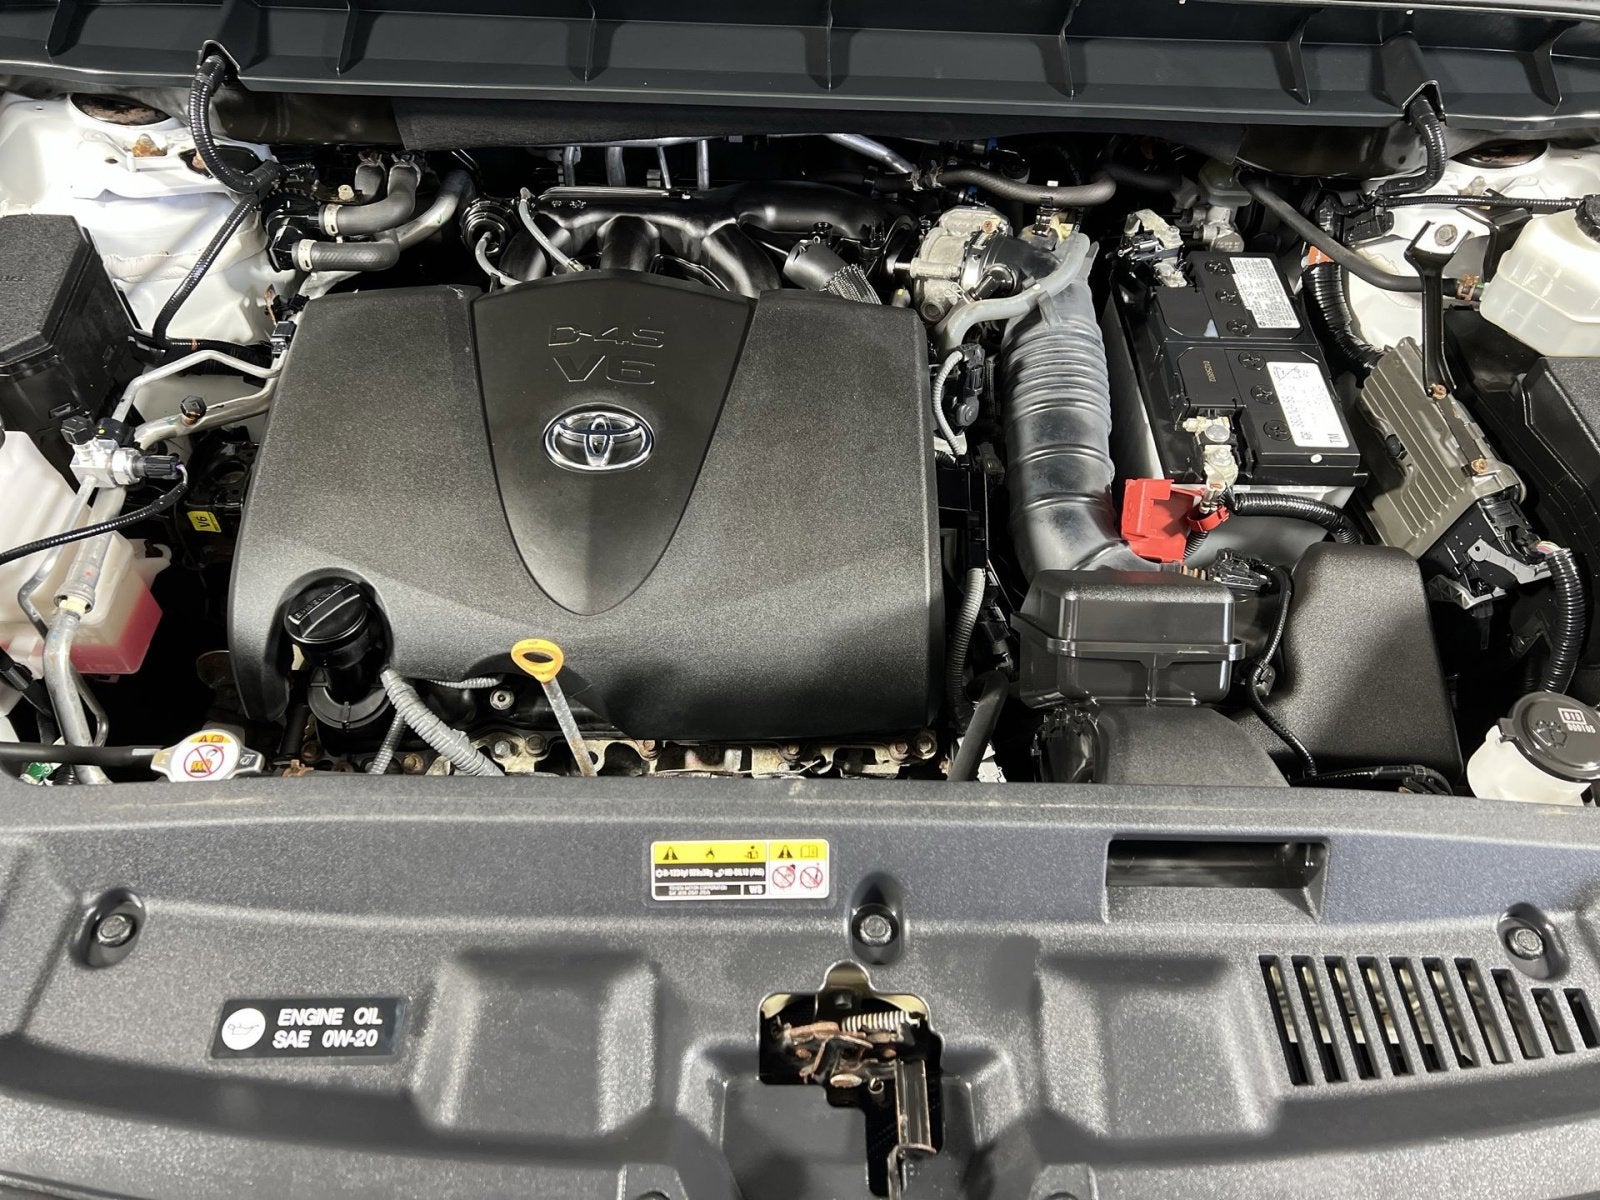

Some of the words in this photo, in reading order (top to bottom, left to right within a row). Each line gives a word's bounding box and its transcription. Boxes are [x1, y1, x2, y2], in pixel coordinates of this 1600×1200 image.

[549, 323, 664, 348] D-4S
[553, 354, 655, 385] V6
[277, 1007, 345, 1026] ENGINE
[353, 1007, 383, 1025] OIL
[272, 1030, 312, 1048] SAE
[322, 1029, 378, 1047] 0W-20
